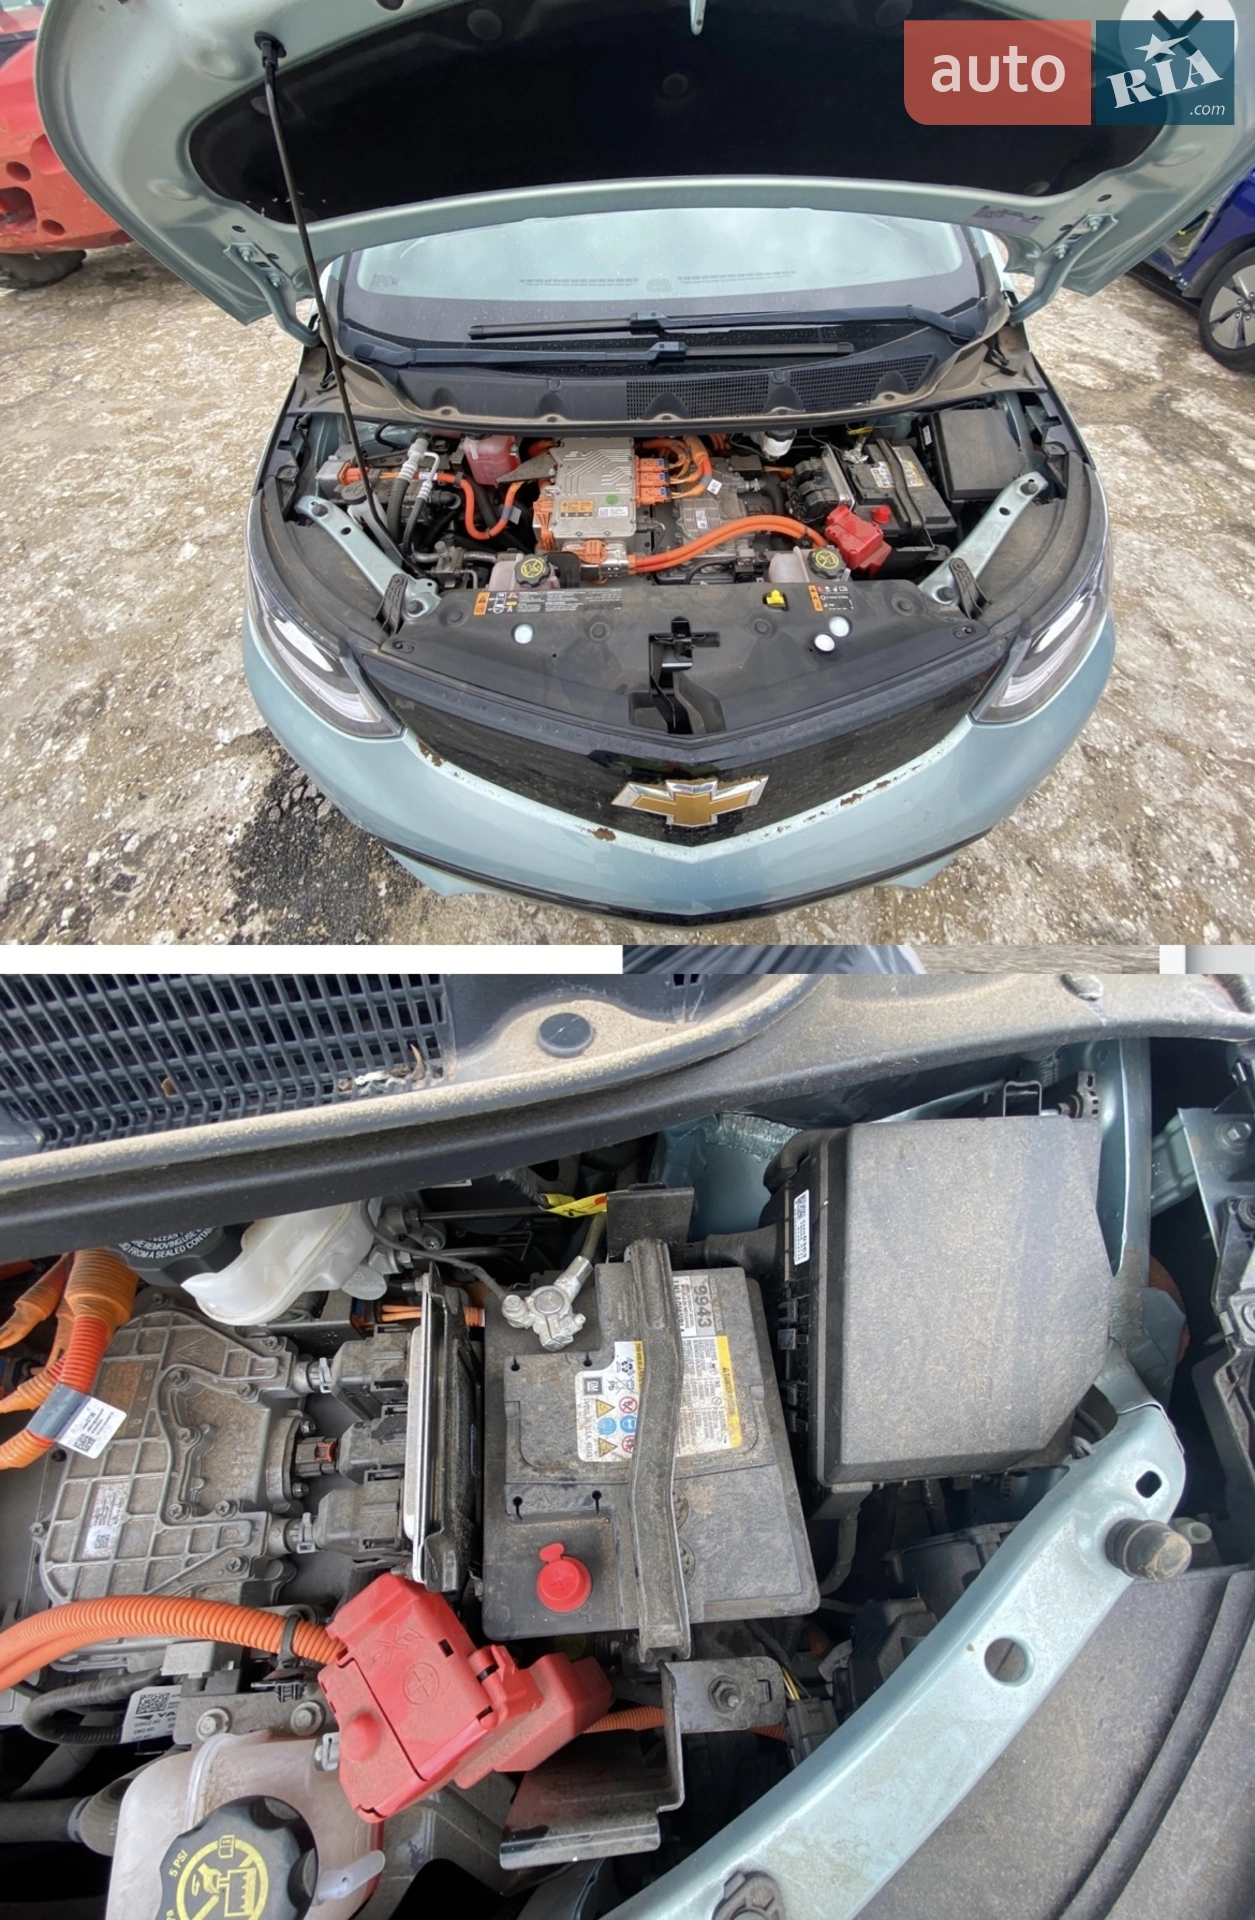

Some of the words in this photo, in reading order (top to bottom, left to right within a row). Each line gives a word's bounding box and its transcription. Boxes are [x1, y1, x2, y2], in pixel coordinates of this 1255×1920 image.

[127, 1246, 149, 1258] FROM
[155, 1245, 186, 1259] SEALED
[693, 1285, 713, 1328] 9943
[590, 1381, 599, 1391] GM
[608, 1381, 616, 1391] Pb
[168, 1867, 178, 1877] 5
[173, 1849, 188, 1868] PSI
